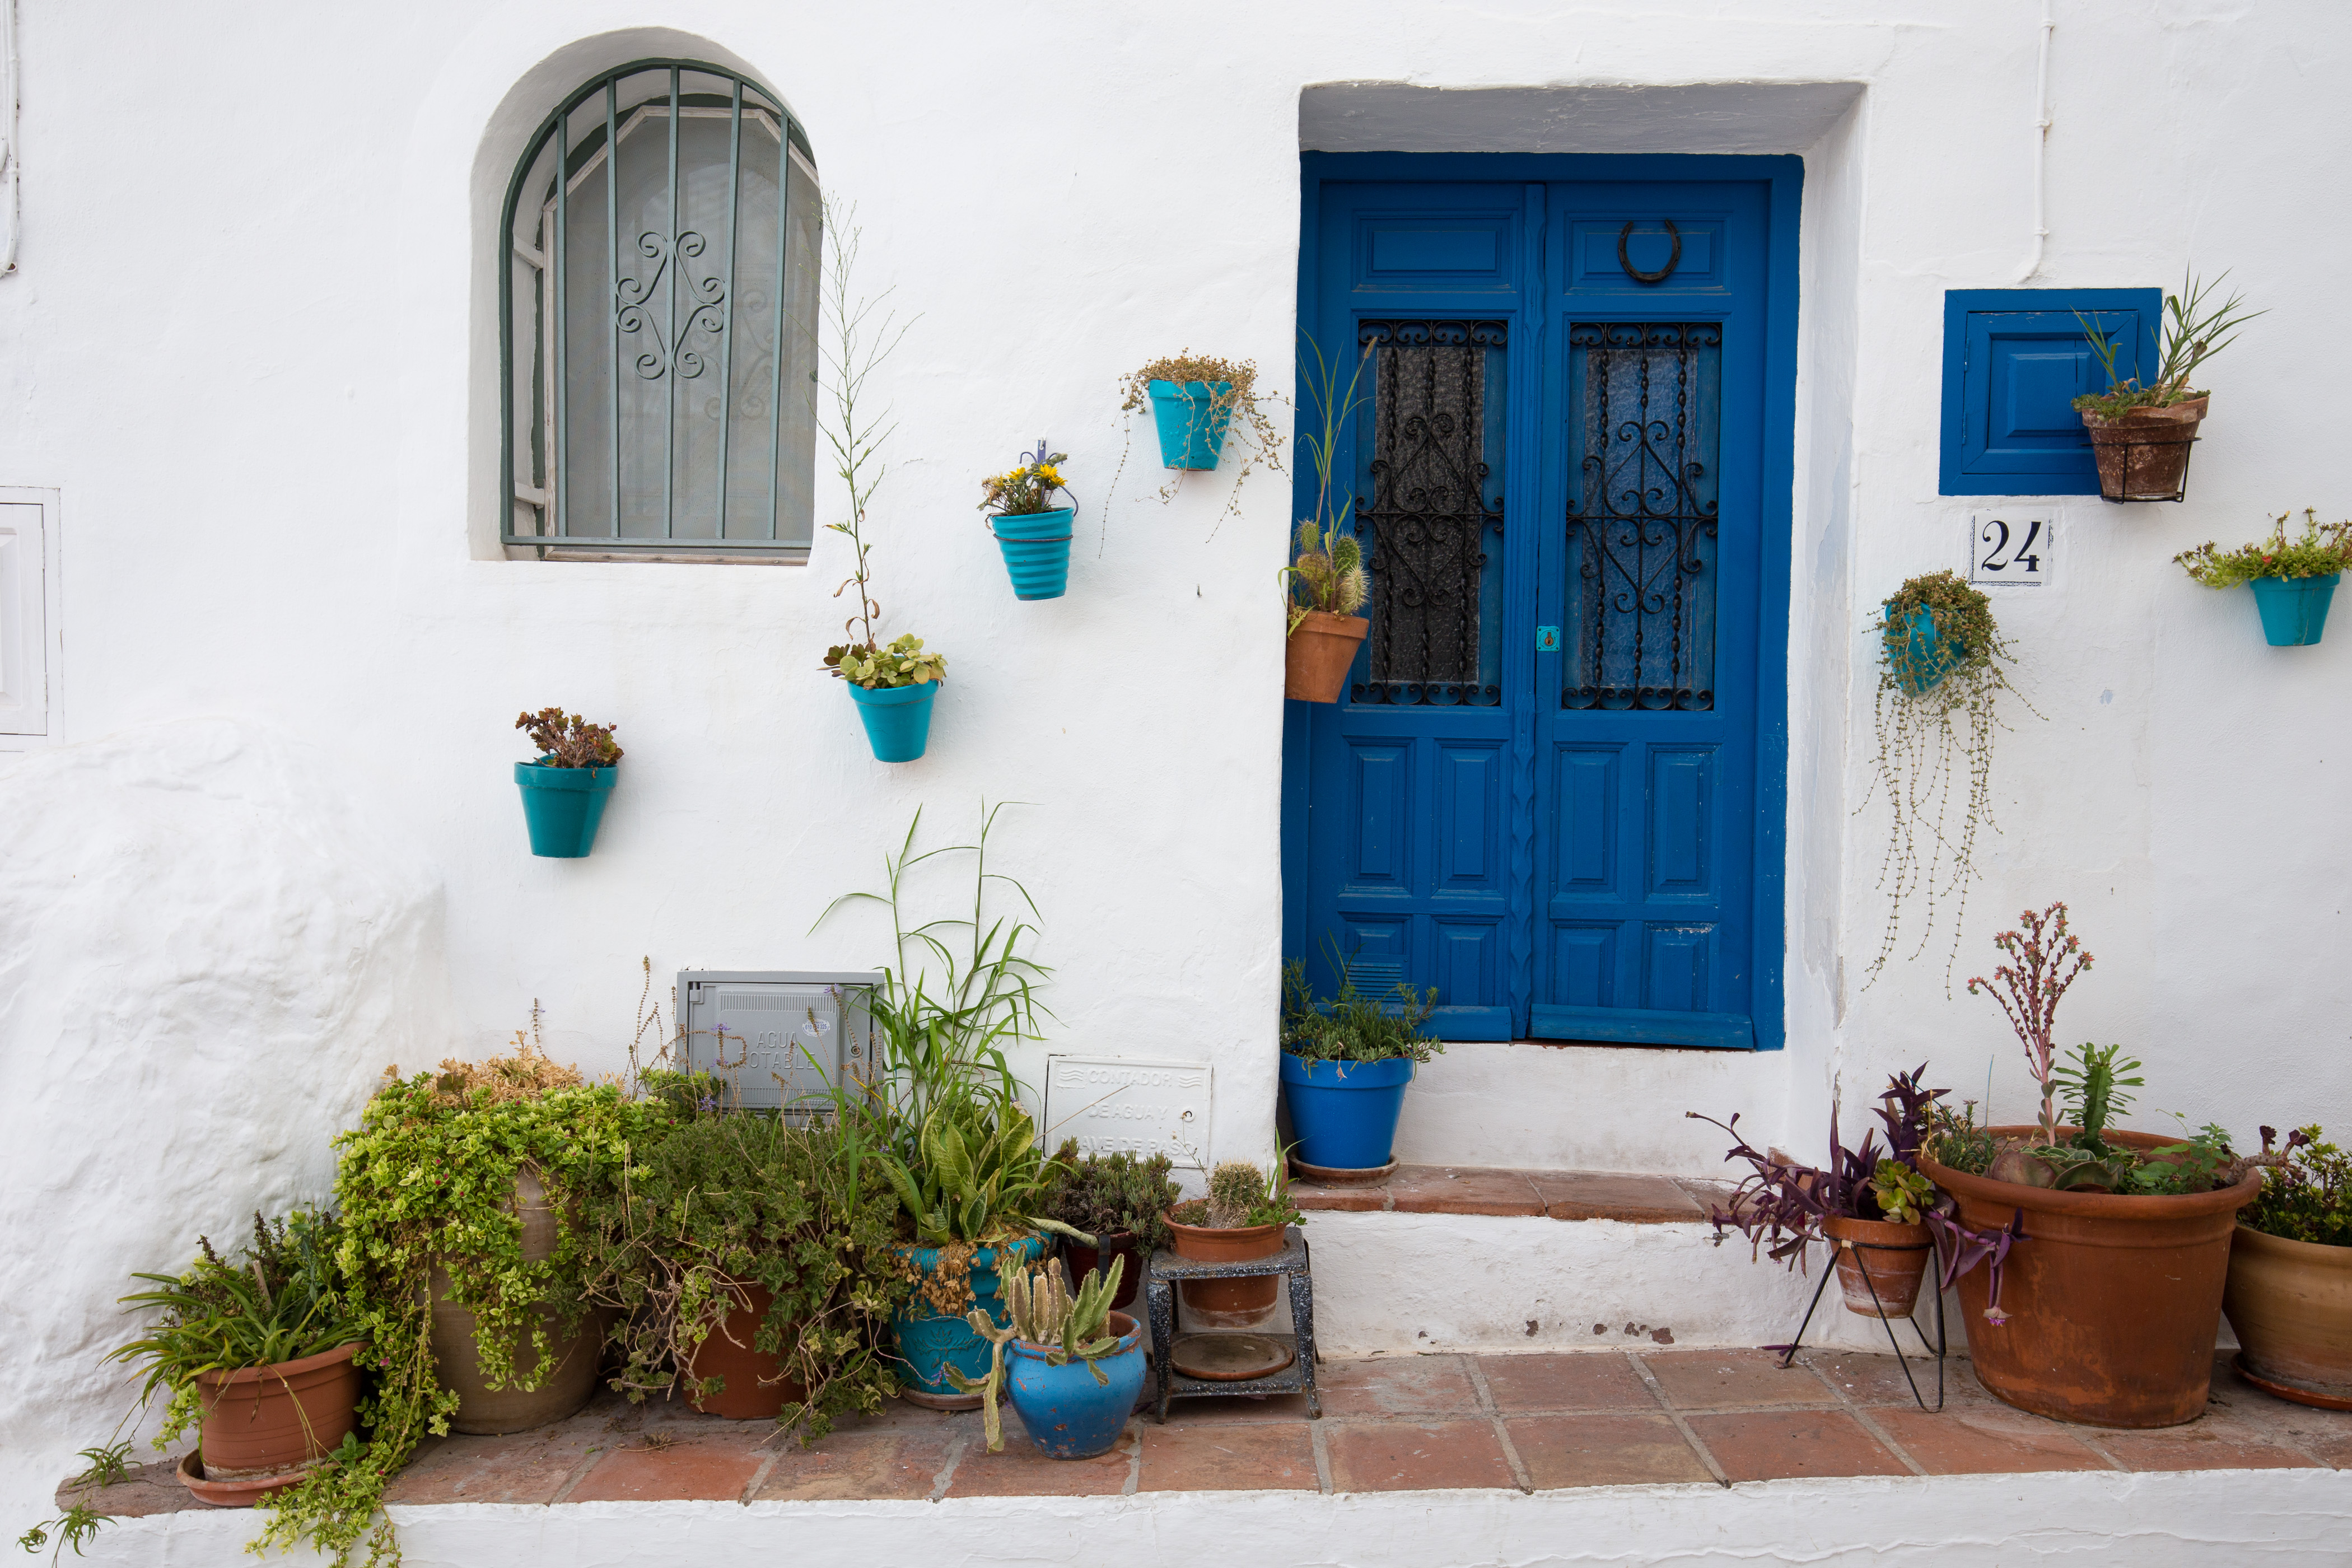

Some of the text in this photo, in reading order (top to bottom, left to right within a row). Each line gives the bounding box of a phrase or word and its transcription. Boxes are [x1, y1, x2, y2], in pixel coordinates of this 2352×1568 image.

[1981, 520, 2042, 572] 24
[757, 1031, 798, 1048] AGUA
[1088, 1068, 1173, 1087] CONTADOR
[1088, 1103, 1169, 1120] DE AGUA Y
[1062, 1135, 1197, 1156] AVE DE PASO
